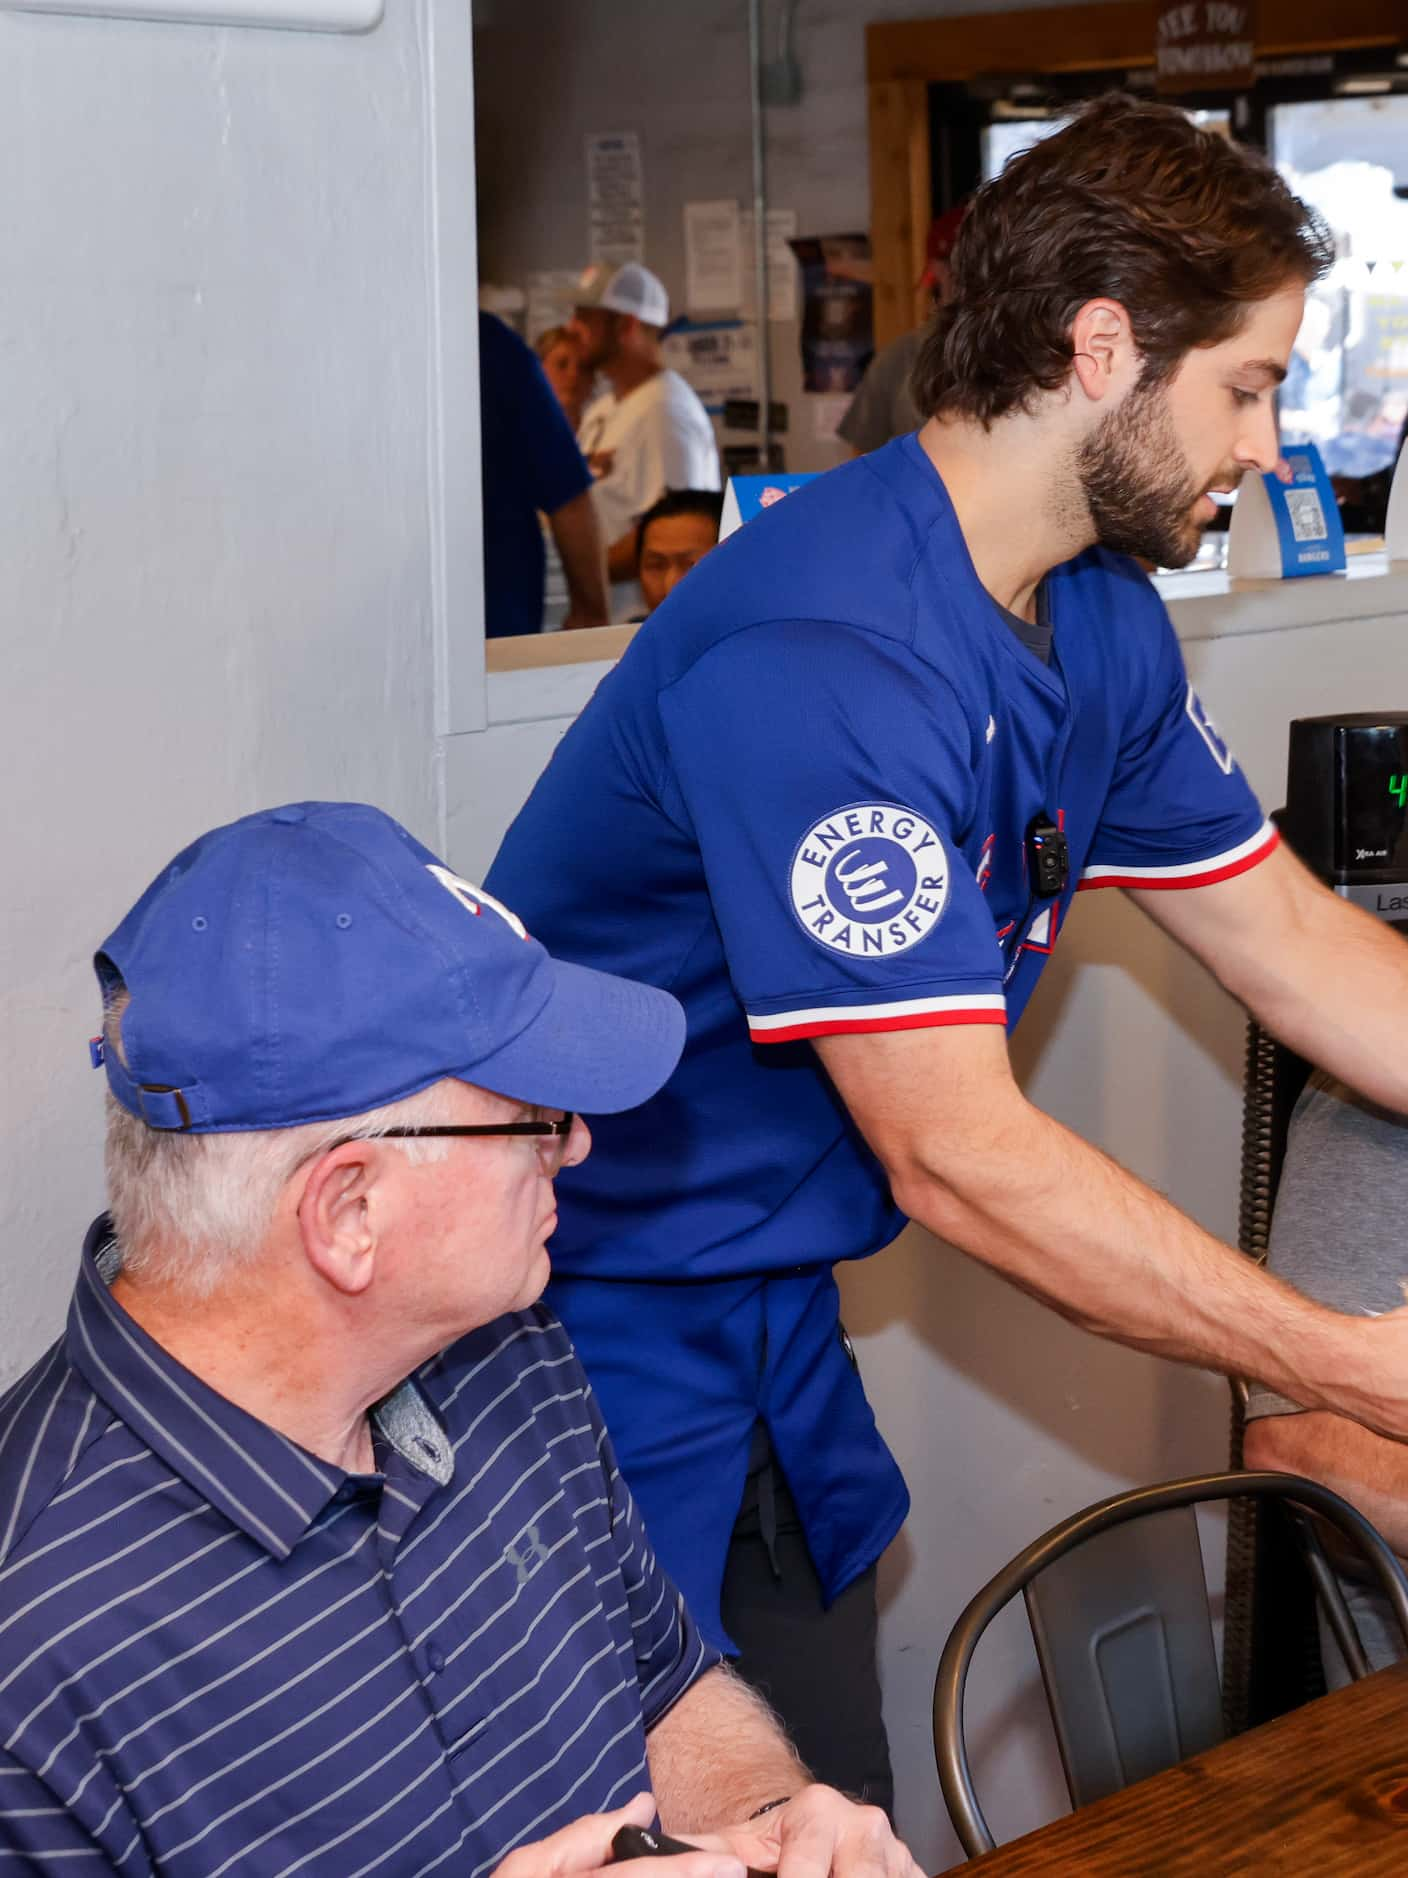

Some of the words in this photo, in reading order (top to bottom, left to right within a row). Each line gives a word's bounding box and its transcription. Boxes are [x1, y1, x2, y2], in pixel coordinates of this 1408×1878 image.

[1388, 774, 1408, 808] 4
[801, 810, 935, 868] ENERGY
[801, 873, 945, 953] TRANSFER
